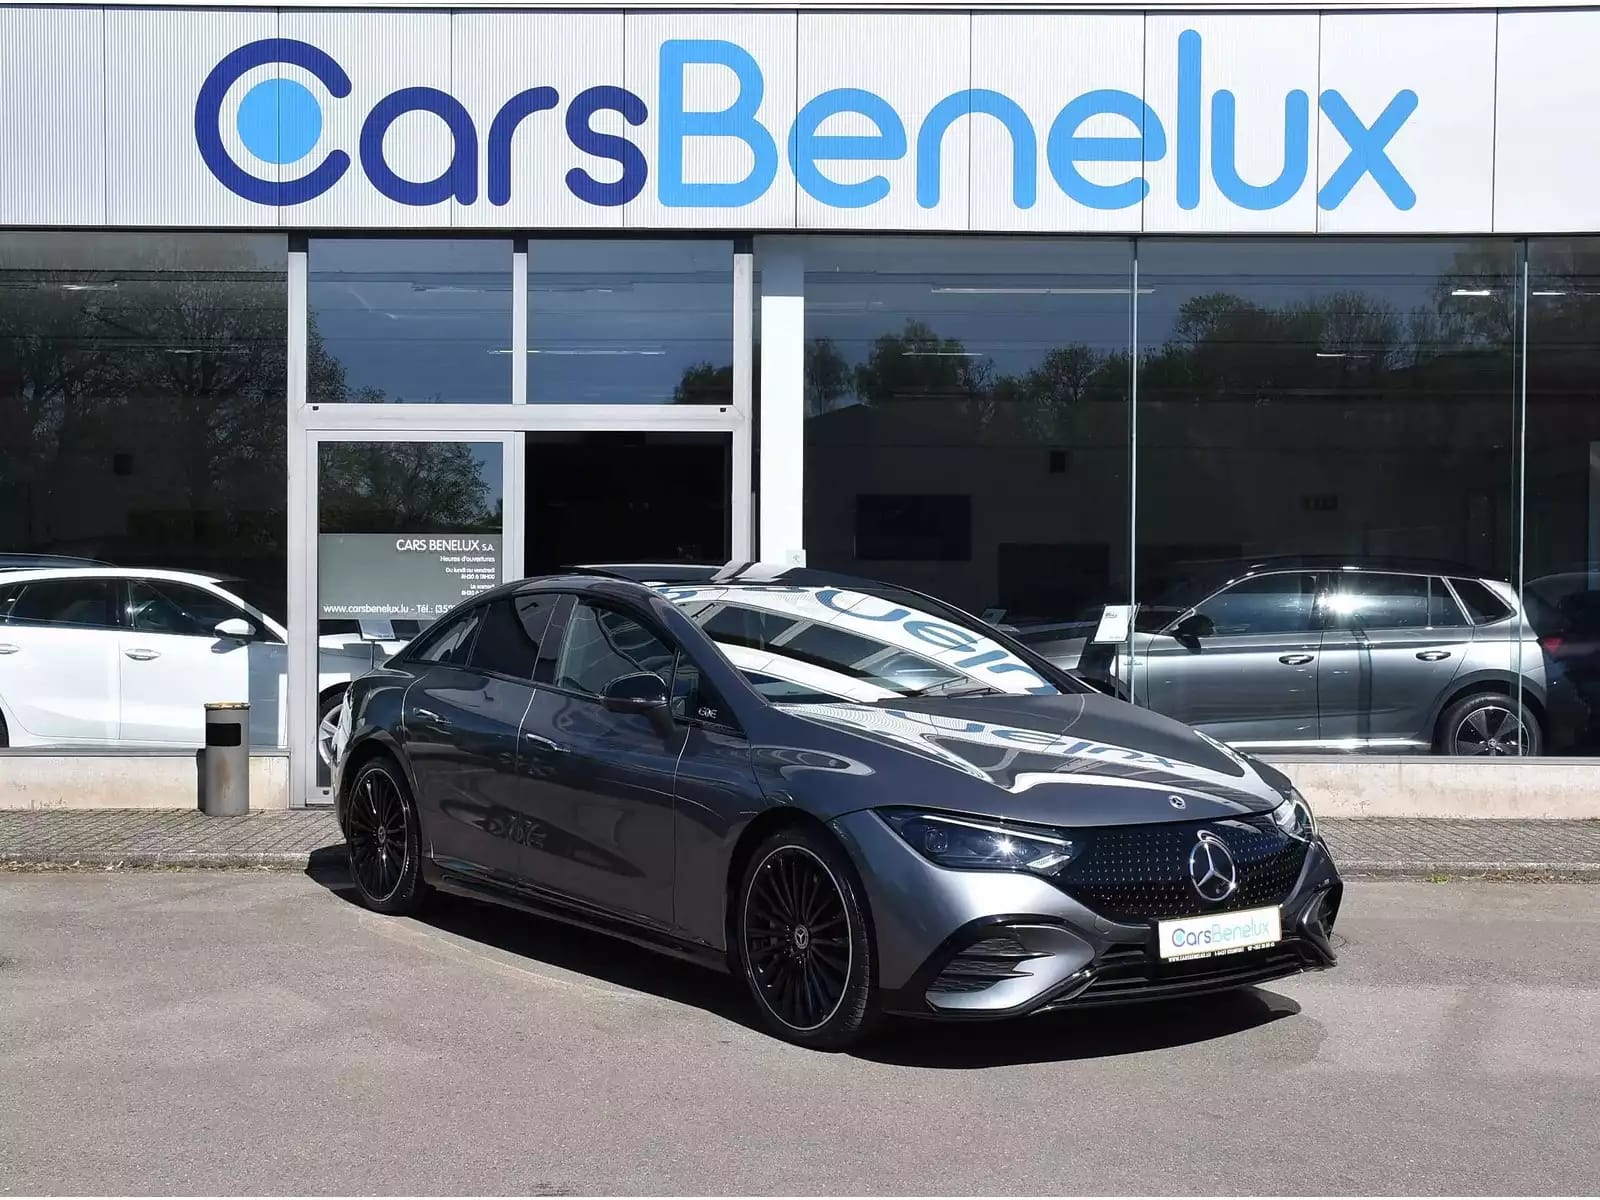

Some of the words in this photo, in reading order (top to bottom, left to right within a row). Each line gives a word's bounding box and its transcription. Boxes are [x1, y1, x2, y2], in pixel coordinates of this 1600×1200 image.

[194, 29, 1419, 211] CarsBenelux
[396, 539, 427, 551] CARS
[429, 539, 480, 551] BENELUX
[481, 543, 495, 552] S.A.
[323, 603, 409, 614] www.carsbenelux.lu
[1171, 917, 1270, 947] CarsBenelux
